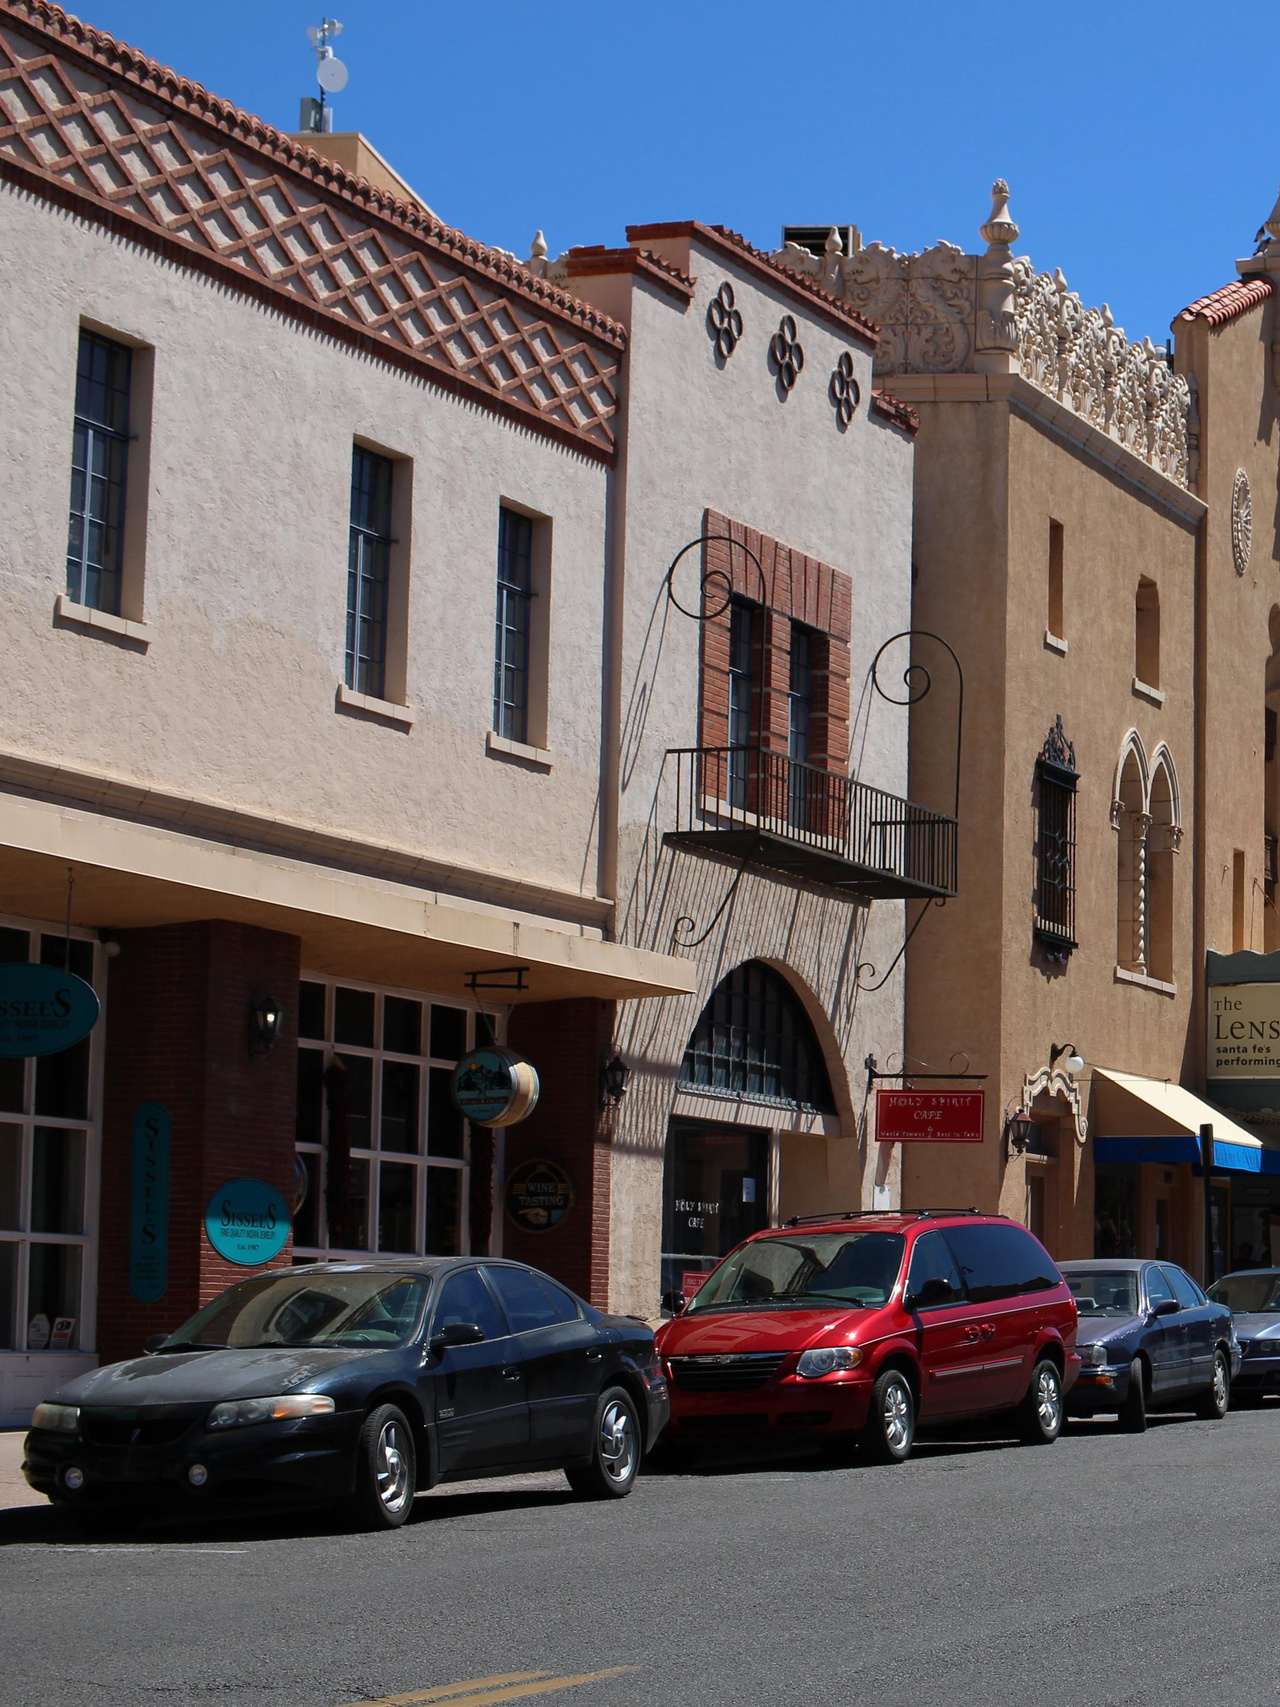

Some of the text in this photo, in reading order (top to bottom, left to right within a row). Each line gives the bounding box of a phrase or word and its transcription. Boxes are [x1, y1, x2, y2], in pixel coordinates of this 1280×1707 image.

[1214, 996, 1243, 1011] The
[1216, 1044, 1271, 1054] santa fe's
[889, 1096, 972, 1108] HOLY SPIRIT
[913, 1110, 943, 1120] CAFE
[526, 1182, 556, 1193] WINE
[518, 1196, 564, 1207] TASTING
[675, 1199, 720, 1214] HOLY SPIRIT
[221, 1200, 277, 1230] SISSEL'S
[688, 1217, 705, 1229] CAFE
[229, 1228, 245, 1239] QUALITY
[259, 1230, 276, 1240] JEWELRY
